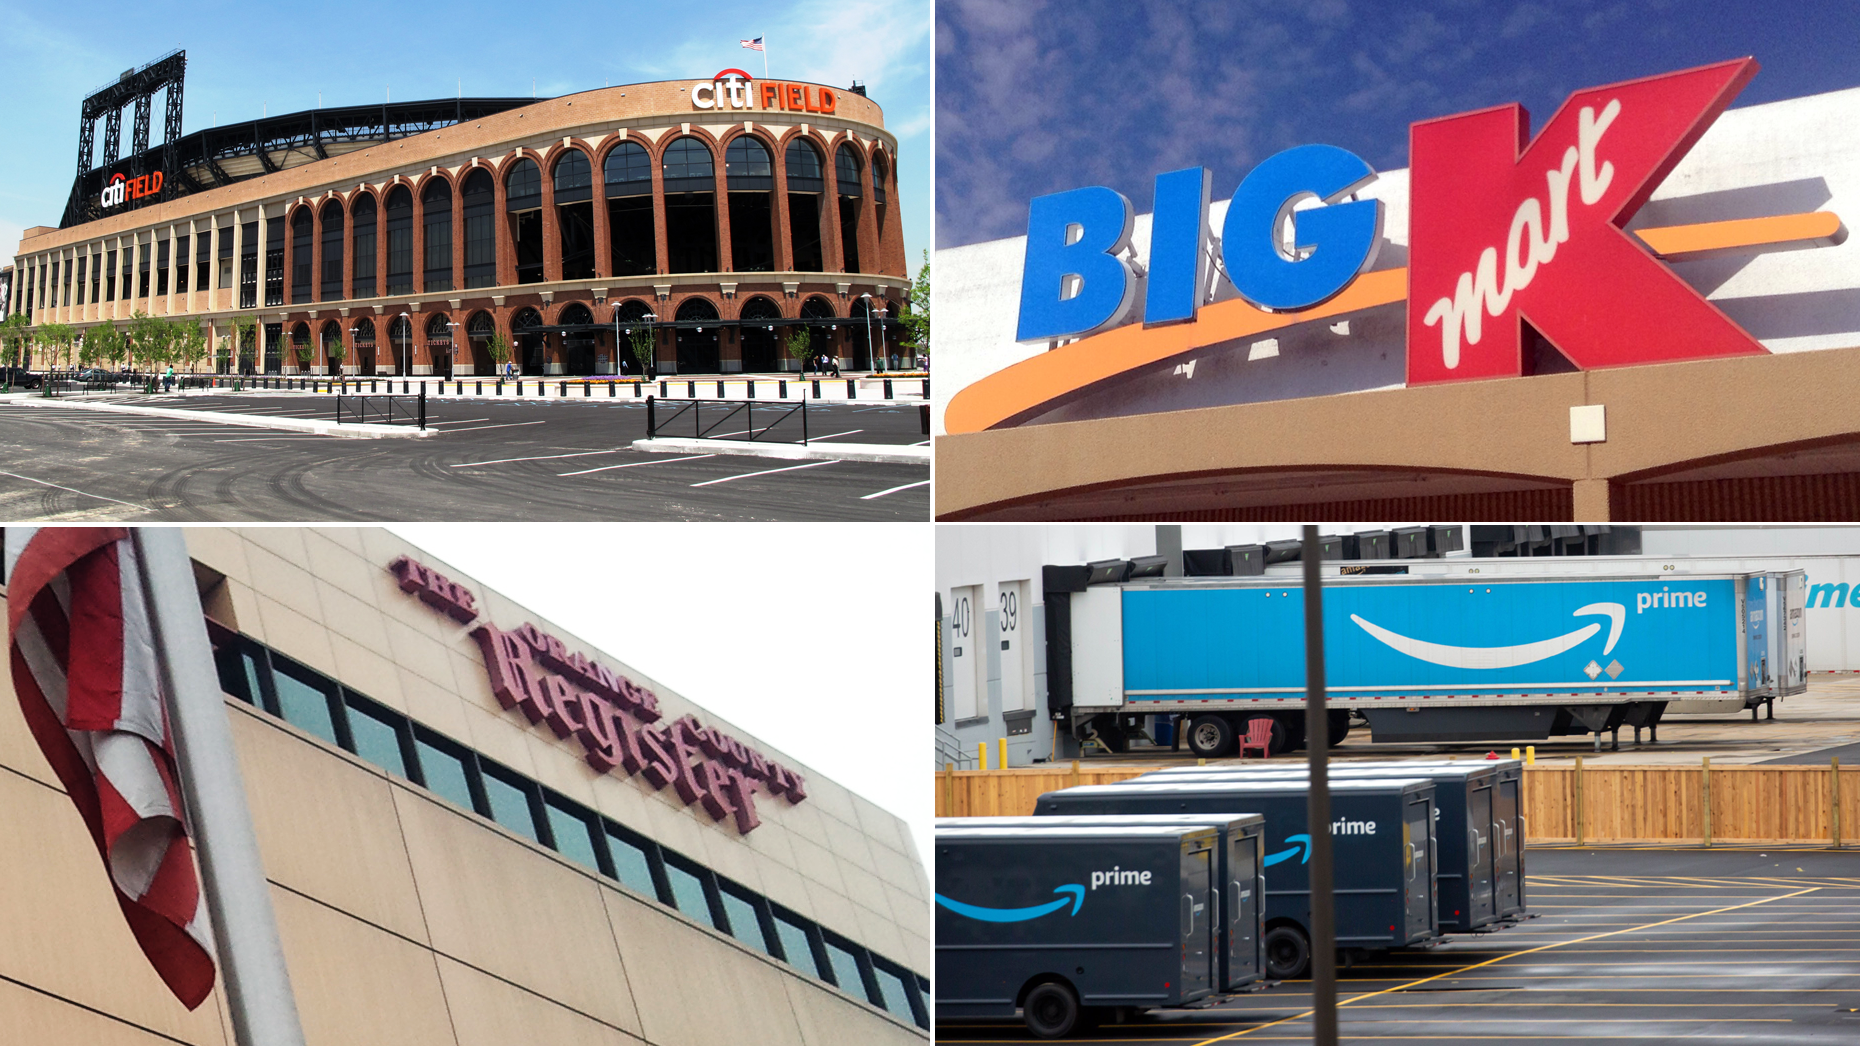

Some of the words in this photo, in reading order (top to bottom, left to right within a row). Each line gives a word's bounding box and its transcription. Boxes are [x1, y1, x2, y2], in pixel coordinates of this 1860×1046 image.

[692, 70, 753, 109] citi
[761, 83, 836, 113] FIELD
[101, 175, 125, 208] citi
[125, 171, 163, 201] FIELD
[1016, 143, 1384, 342] BIG
[1406, 56, 1767, 387] K
[1424, 98, 1621, 369] mart
[952, 597, 970, 638] 40
[1000, 591, 1017, 632] 39
[1637, 586, 1707, 614] prime
[392, 554, 479, 622] THE
[518, 621, 661, 722] ORANGE
[675, 713, 807, 804] COUNTY
[470, 622, 762, 834] Register
[1328, 816, 1376, 836] rime
[1091, 865, 1152, 891] prime
